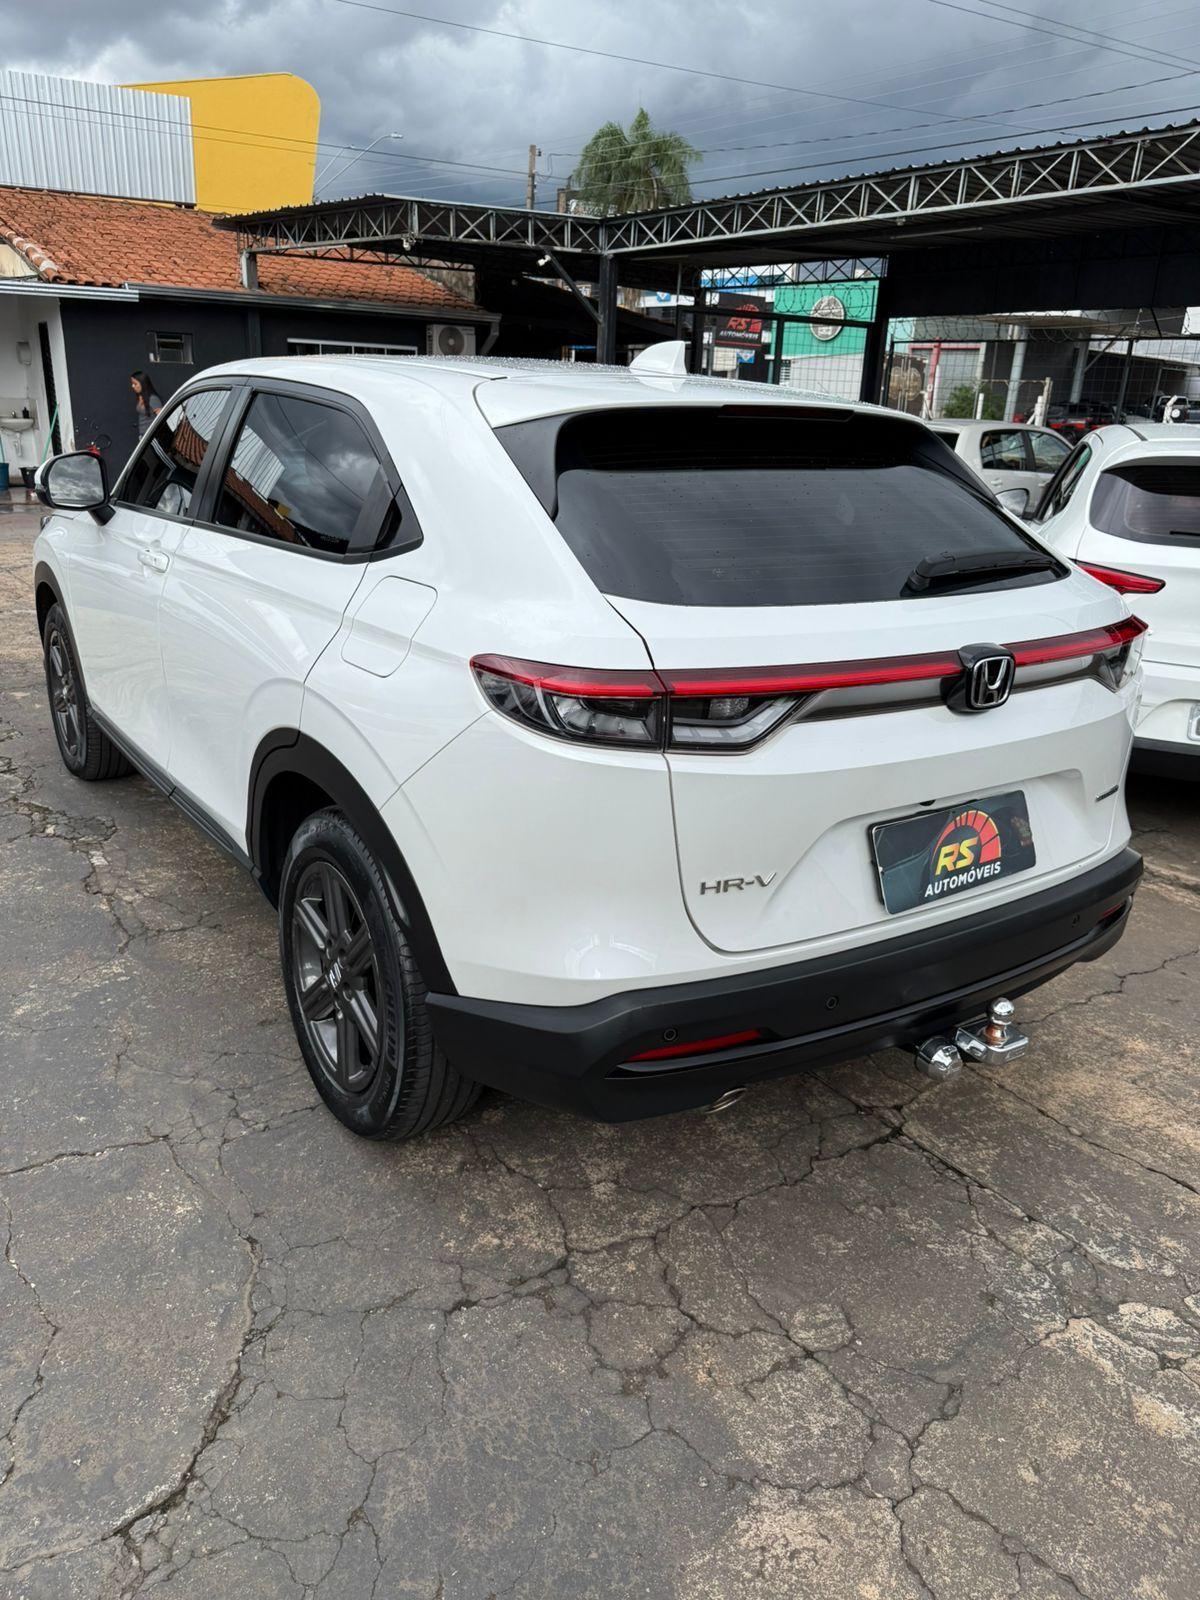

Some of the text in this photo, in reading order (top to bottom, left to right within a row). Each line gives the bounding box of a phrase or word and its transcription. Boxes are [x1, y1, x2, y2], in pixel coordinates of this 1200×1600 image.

[727, 317, 751, 330] RS
[935, 836, 979, 876] RS
[700, 872, 777, 895] HR-V
[924, 861, 1001, 898] AUTOMÓVEIS
